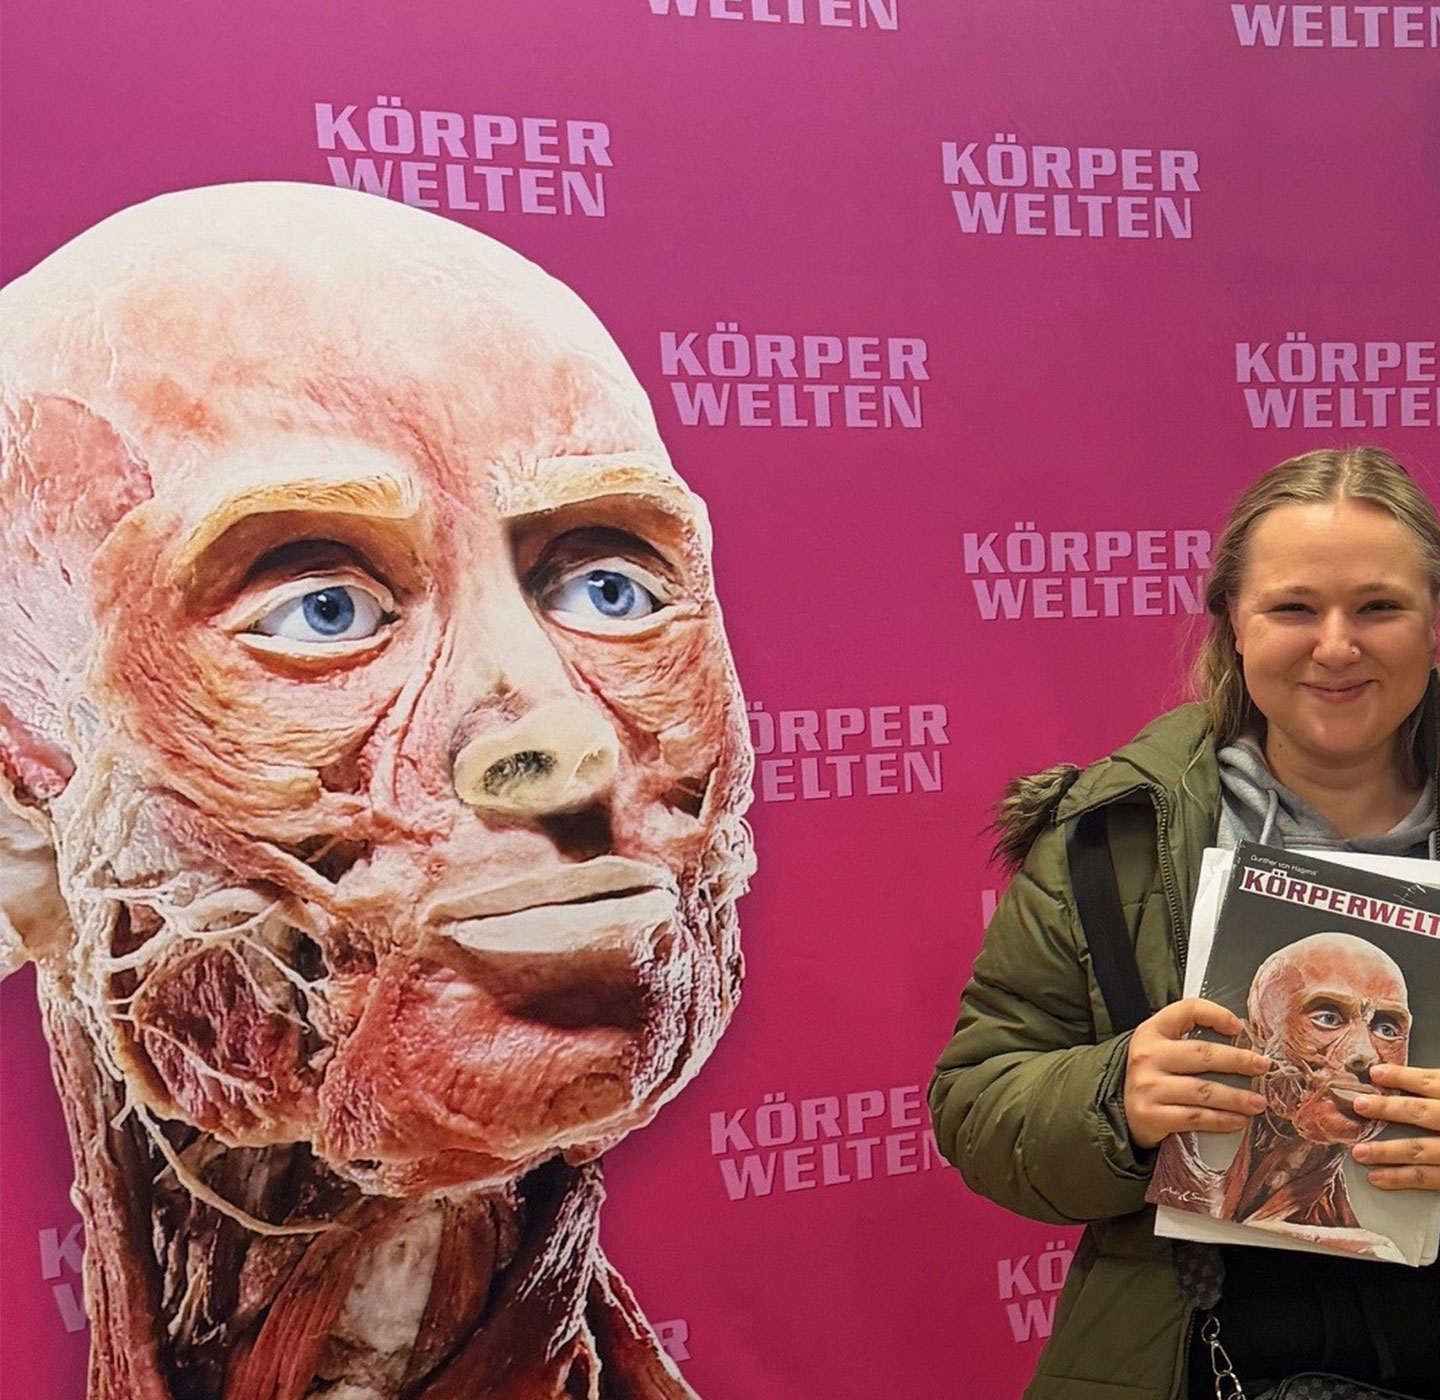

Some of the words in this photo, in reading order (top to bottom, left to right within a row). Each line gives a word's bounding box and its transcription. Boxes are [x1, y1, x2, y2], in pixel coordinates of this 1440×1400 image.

[313, 95, 614, 167] KÖRPER
[327, 157, 607, 218] WELTEN
[941, 133, 1201, 192] KÖRPER
[950, 190, 1193, 239] WELTEN
[659, 321, 930, 381] KÖRPER
[670, 381, 923, 429] WELTEN
[963, 521, 1213, 574] KÖRPER
[972, 575, 1205, 621] WELTEN
[745, 701, 950, 755] ÖRPER
[761, 750, 943, 803] ELTEN
[709, 1084, 923, 1155] KÖRPE
